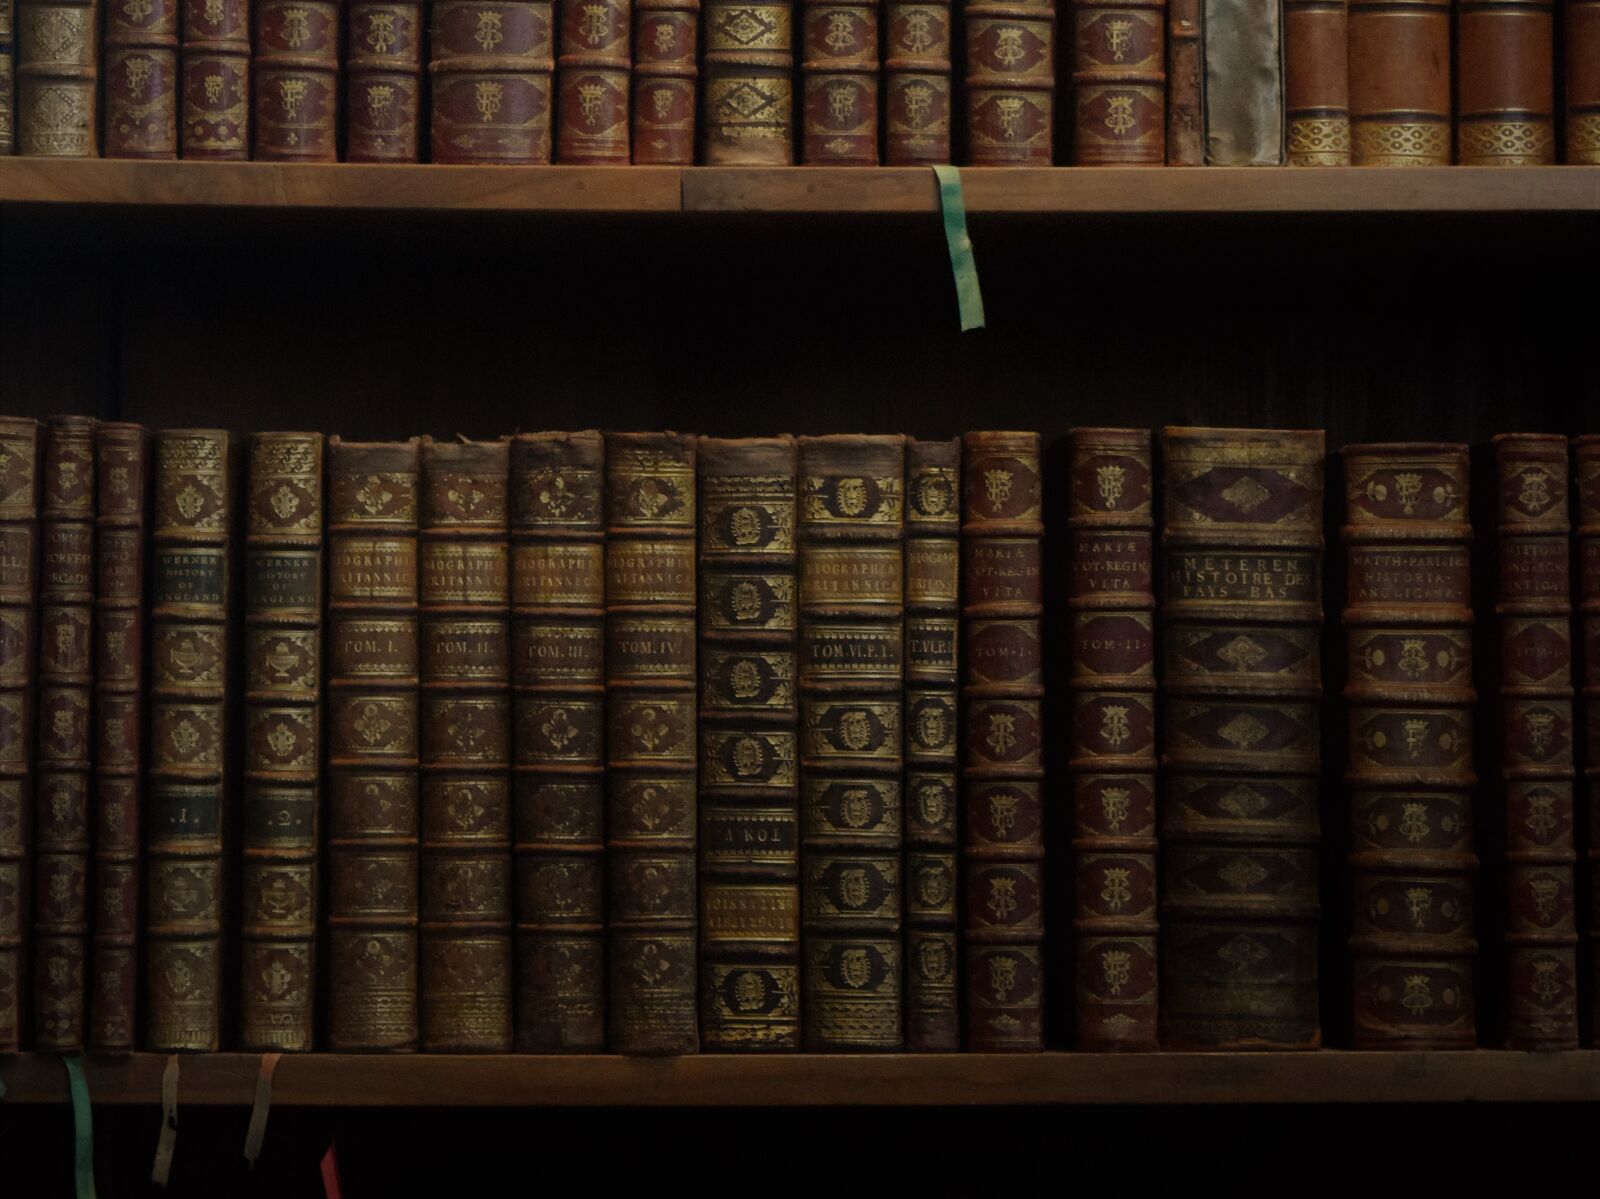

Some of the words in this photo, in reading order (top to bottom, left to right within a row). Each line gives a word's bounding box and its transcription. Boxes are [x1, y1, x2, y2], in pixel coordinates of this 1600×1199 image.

[1184, 558, 1298, 572] METEREN
[1089, 578, 1131, 589] VITA
[1171, 570, 1273, 584] HISTOIRE
[1284, 573, 1311, 586] DES
[158, 592, 220, 601] NGLAND
[983, 586, 1024, 597] VITA
[568, 645, 589, 658] III.
